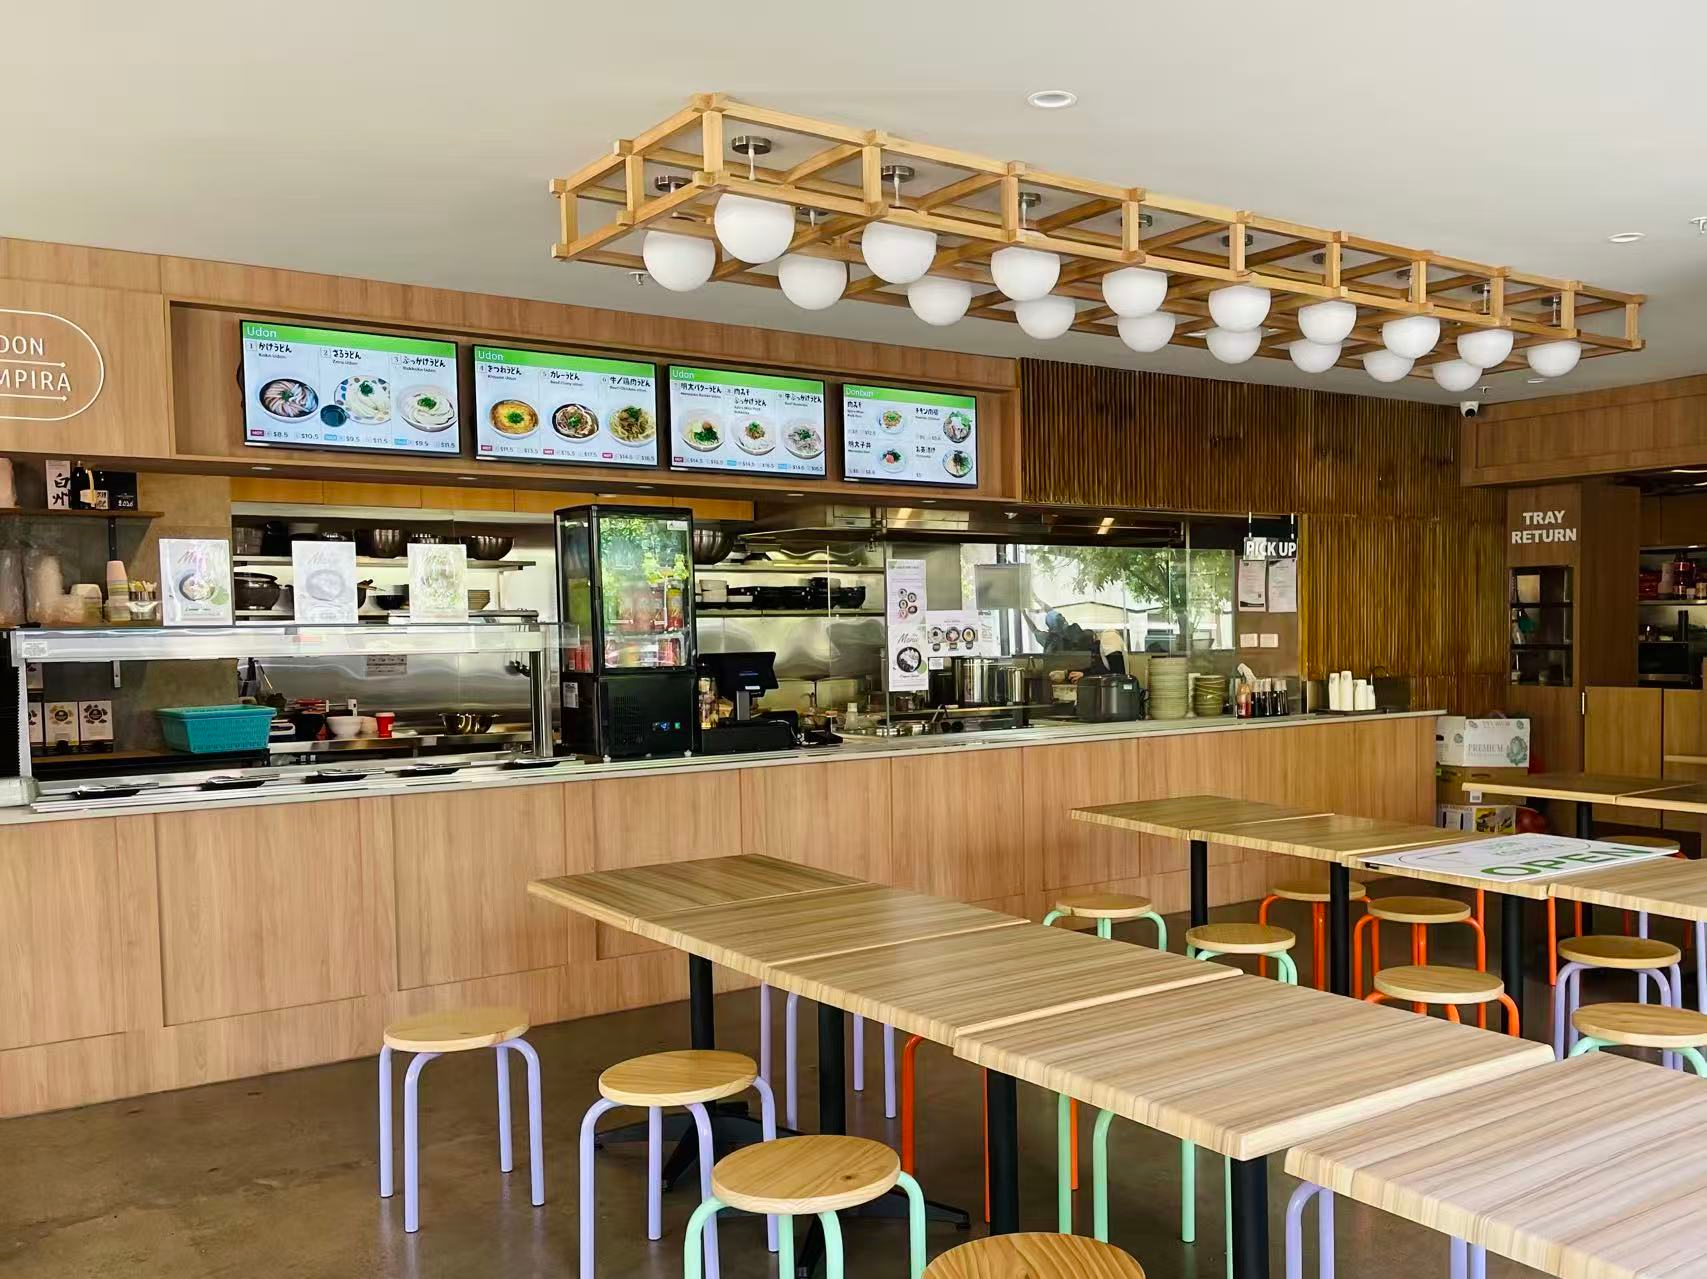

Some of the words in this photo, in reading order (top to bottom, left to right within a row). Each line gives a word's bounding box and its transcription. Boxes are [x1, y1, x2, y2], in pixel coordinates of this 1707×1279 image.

[247, 326, 277, 337] Udon
[258, 342, 292, 353] かけうどん
[478, 350, 504, 361] Udon
[402, 356, 446, 368] ぶっかけうどん
[487, 364, 522, 375] きつねうどん
[672, 369, 695, 379] Udon
[550, 370, 580, 381] カレーうどん
[1522, 510, 1566, 525] TRAY
[1511, 528, 1577, 544] RETURN
[1246, 540, 1277, 556] PICK
[1278, 541, 1297, 557] UP
[1468, 743, 1504, 753] PREMIUM
[1480, 847, 1653, 877] OPEN
